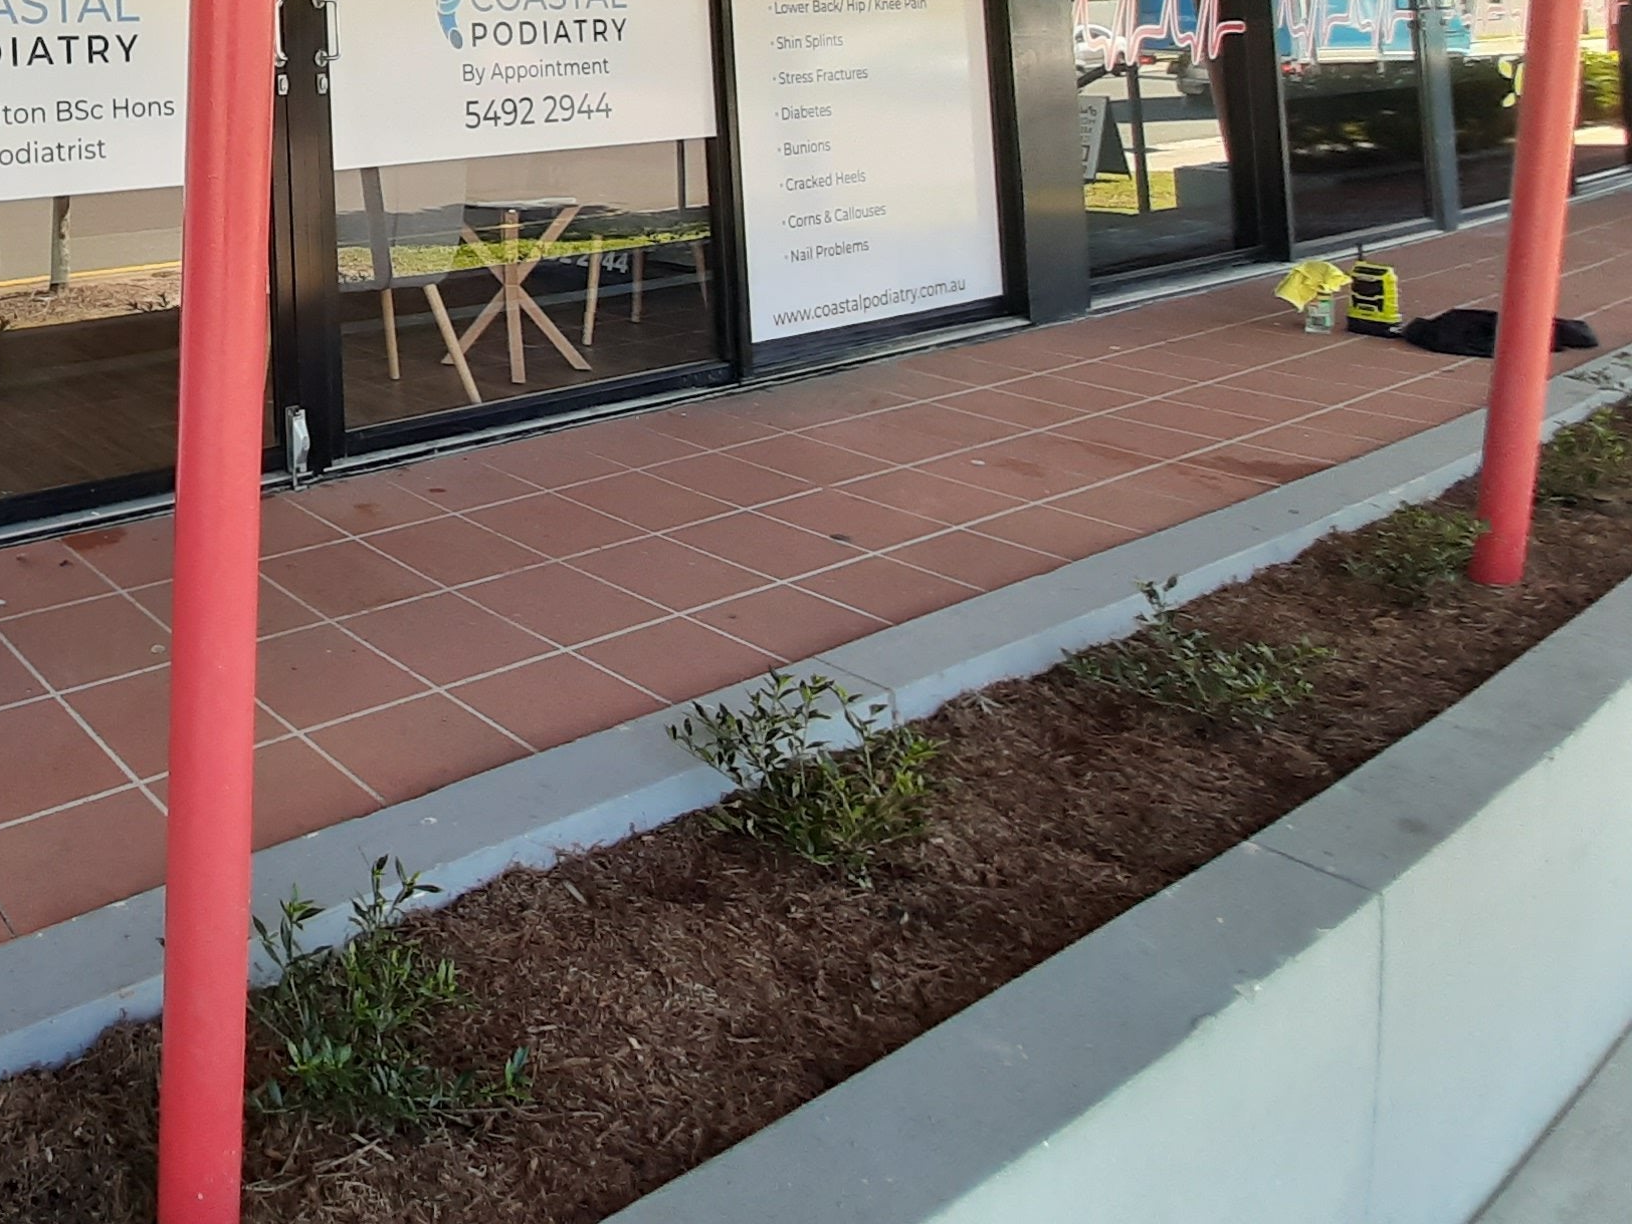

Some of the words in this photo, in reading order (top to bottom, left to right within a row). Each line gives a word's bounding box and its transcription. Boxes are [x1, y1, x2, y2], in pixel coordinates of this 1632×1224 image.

[775, 2, 809, 14] Lower
[847, 0, 865, 13] Hip
[472, 18, 626, 47] PODIATRY
[777, 36, 802, 49] Shin
[805, 35, 843, 50] Splints
[463, 64, 485, 85] By
[491, 58, 609, 83] Appointment
[779, 72, 813, 85] Stress
[817, 69, 868, 82] Fractures
[57, 100, 103, 121] BSc
[113, 98, 174, 118] Hons
[466, 97, 535, 128] 5492
[543, 92, 612, 123] 2944
[782, 106, 831, 120] Diabetes
[784, 141, 831, 156] Bunions
[786, 174, 832, 191] Cracked
[836, 170, 865, 184] Heels
[788, 215, 821, 228] Corns
[824, 210, 832, 224] &
[835, 205, 886, 221] Callouses
[791, 248, 812, 262] Nail
[816, 241, 869, 258] Problems
[773, 278, 966, 327] www.coastalpodiatry.com.au
